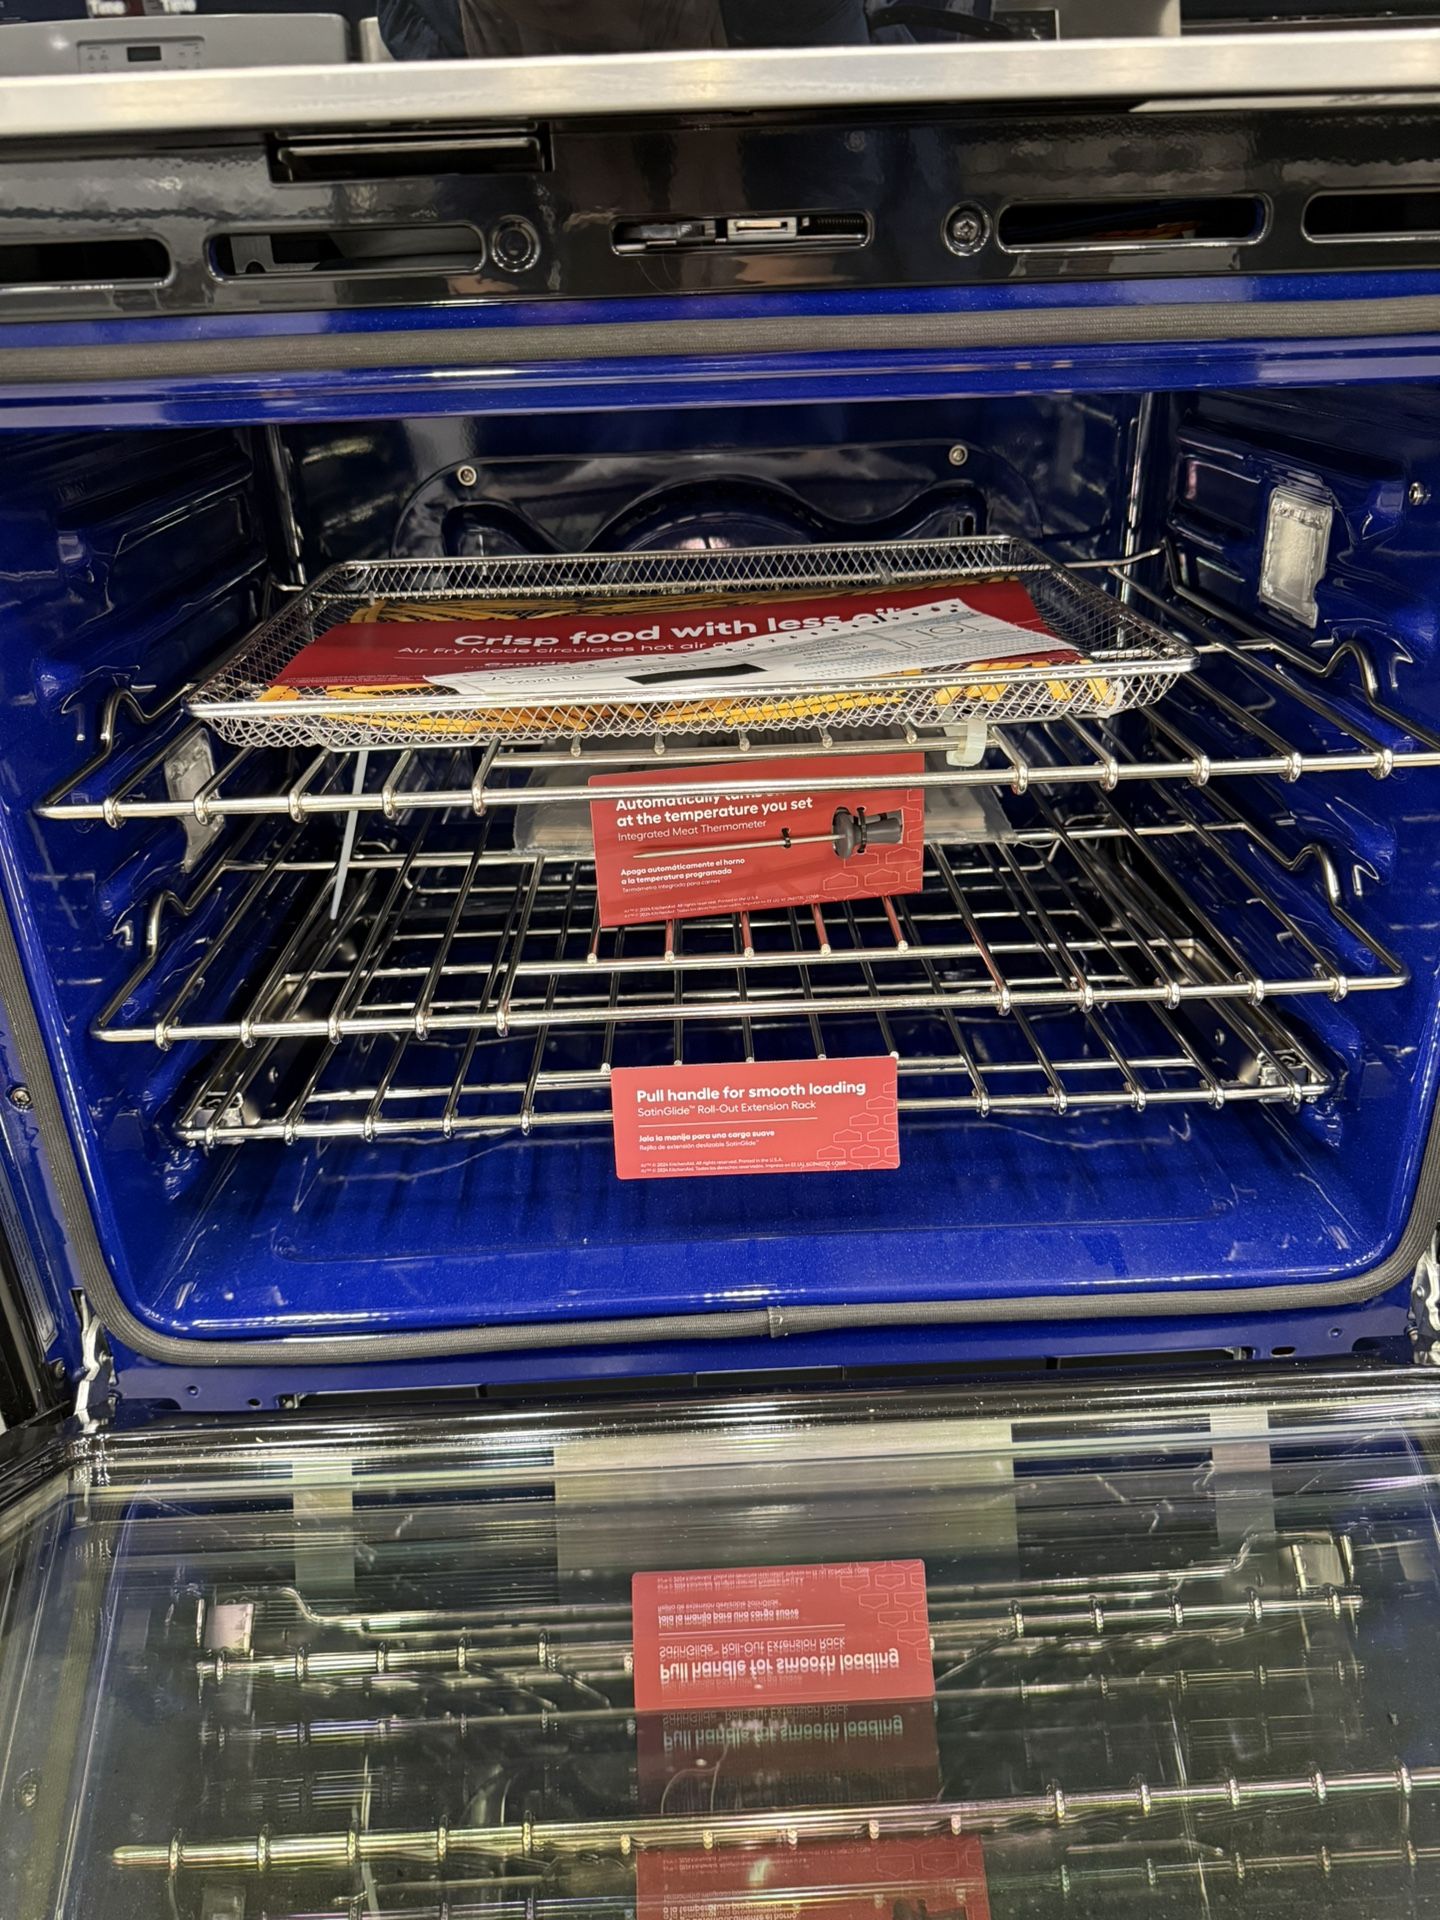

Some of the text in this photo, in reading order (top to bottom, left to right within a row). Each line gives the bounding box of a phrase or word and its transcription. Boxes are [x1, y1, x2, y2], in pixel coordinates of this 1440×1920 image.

[454, 635, 560, 648] Crisp
[569, 625, 661, 645] food
[671, 619, 757, 637] with
[767, 615, 841, 631] less
[433, 647, 465, 655] Fry
[536, 645, 635, 654] circulates
[641, 643, 675, 651] hot
[681, 641, 708, 649] air
[616, 795, 720, 811] Automatically
[616, 797, 813, 828] at the temperature you set
[618, 819, 767, 842] Integrated Meat Thermometer
[621, 868, 647, 878] Apaga
[715, 859, 723, 867] el
[723, 857, 746, 866] horno
[627, 877, 636, 885] la
[636, 873, 685, 884] temperatura
[685, 867, 732, 881] programada
[636, 1080, 866, 1103] Pull handle for smooth loading
[697, 1103, 739, 1115] Roll-Out
[741, 1101, 789, 1113] Extension
[791, 1100, 817, 1110] Rack
[639, 1129, 775, 1144] Jala la manija para una carga suave
[657, 1143, 666, 1151] de
